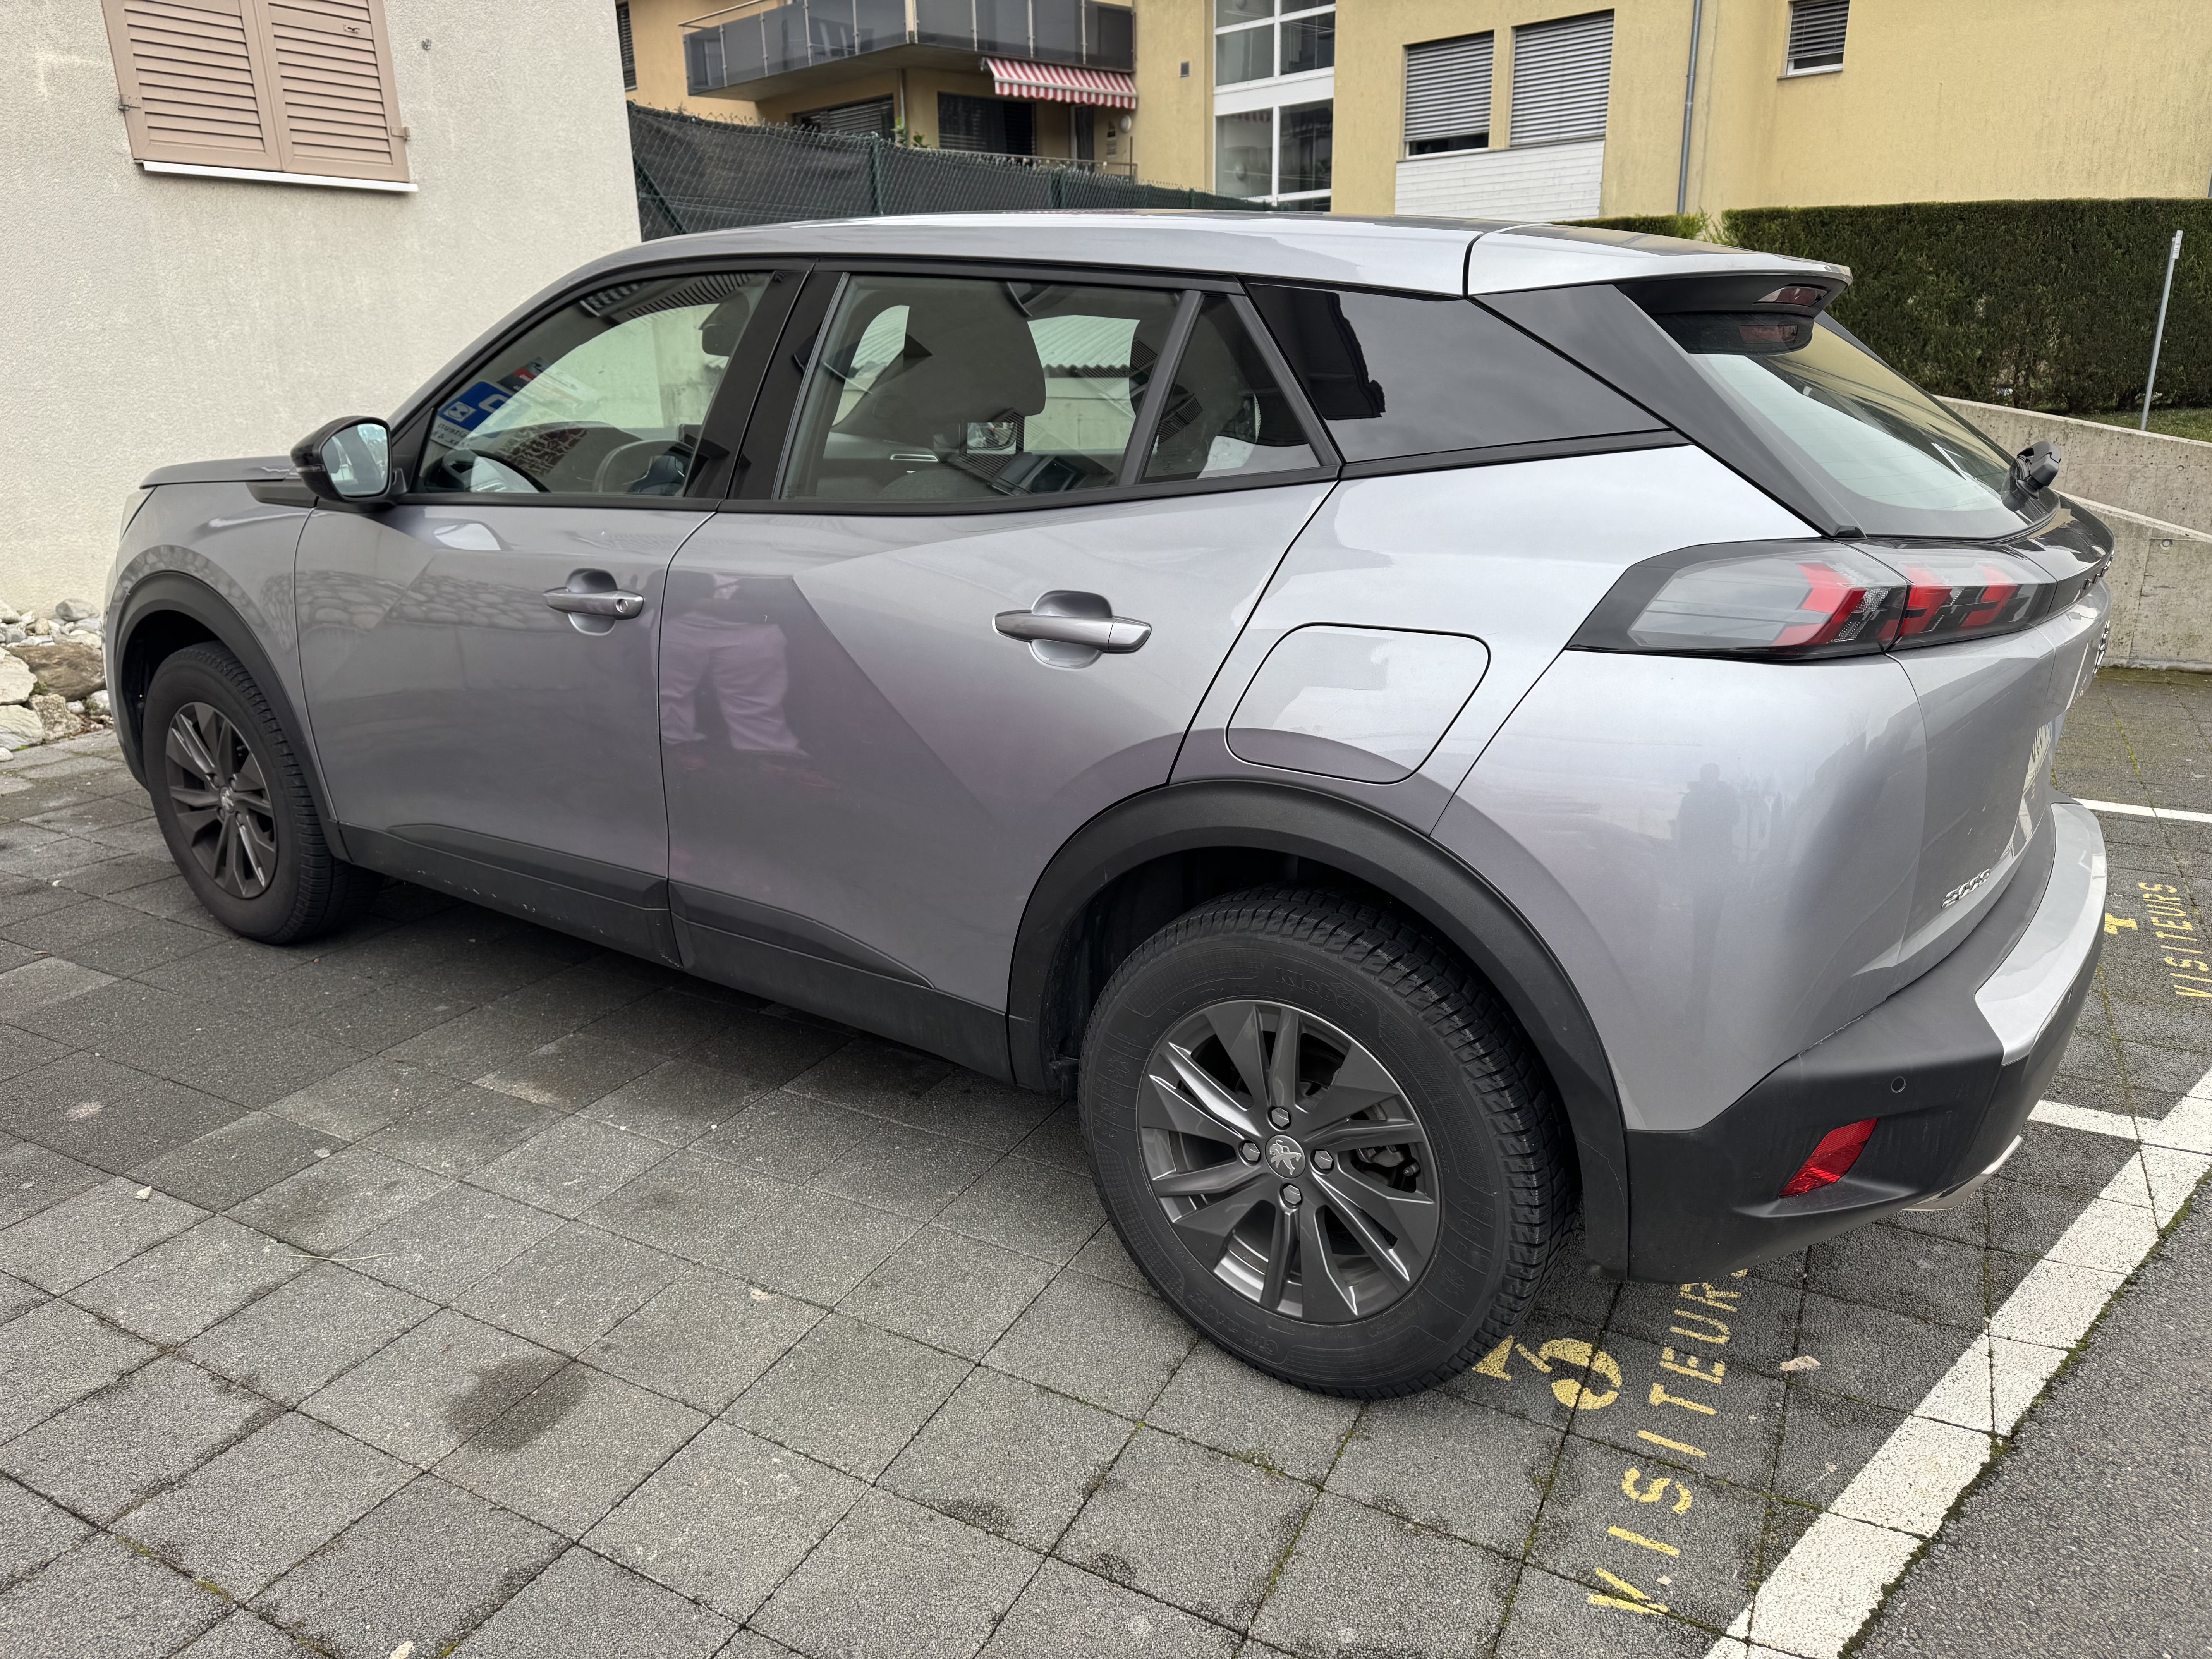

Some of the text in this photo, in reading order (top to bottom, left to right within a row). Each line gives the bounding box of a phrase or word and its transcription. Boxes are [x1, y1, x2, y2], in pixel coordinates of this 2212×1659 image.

[1274, 967, 1367, 1019] Kleber
[2138, 882, 2212, 998] VISITEURS
[1588, 1269, 1748, 1616] VISITEUR
